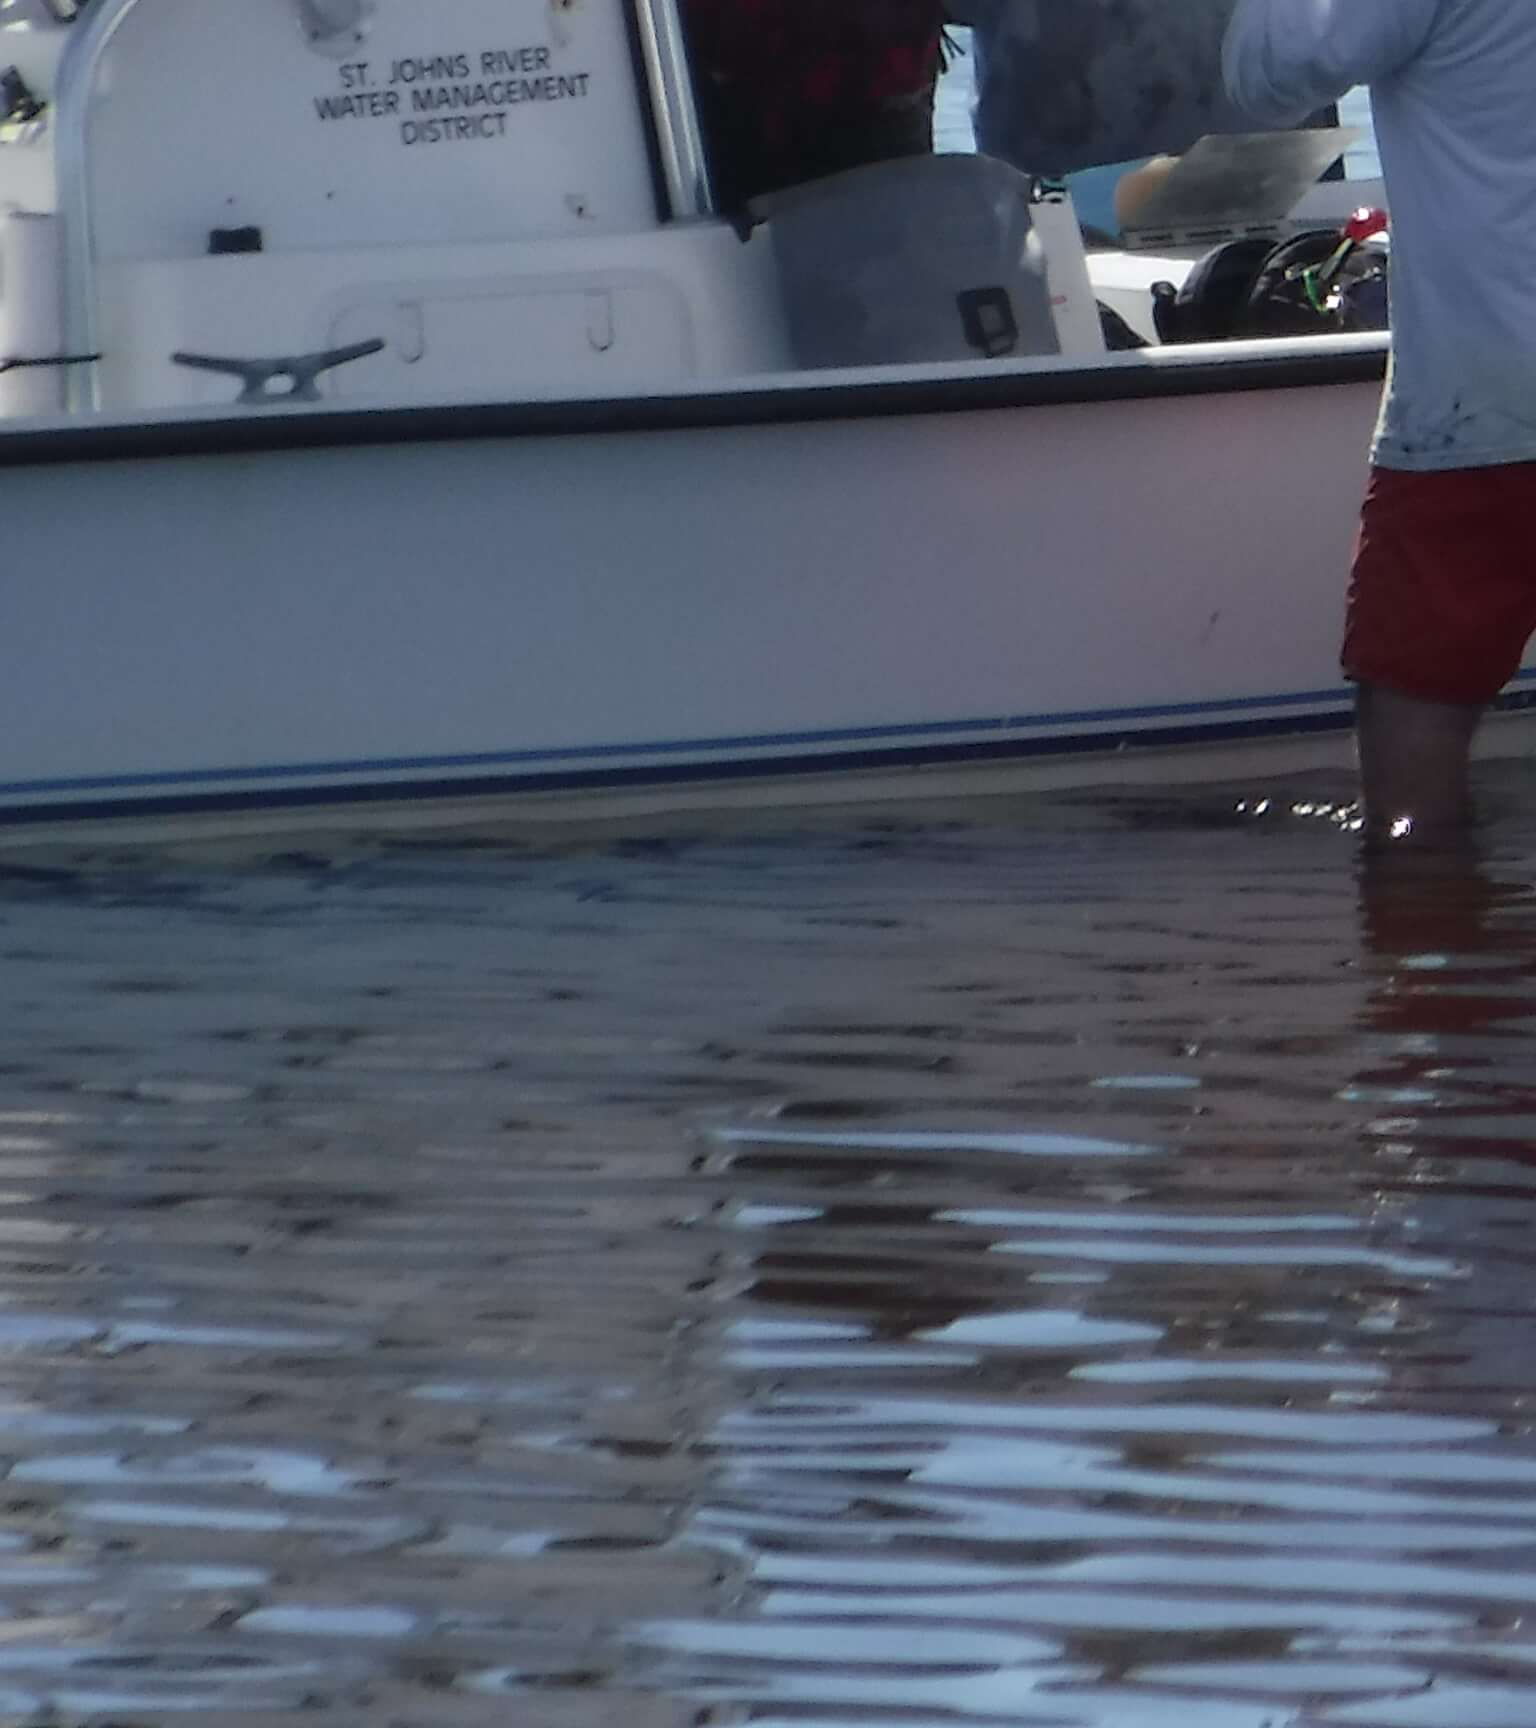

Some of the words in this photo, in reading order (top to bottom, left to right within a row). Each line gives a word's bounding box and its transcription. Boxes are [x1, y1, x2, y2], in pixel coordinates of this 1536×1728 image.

[338, 62, 376, 88] ST.
[389, 54, 470, 85] JOHNS
[480, 47, 551, 73] RIVER
[313, 90, 399, 120] WATER
[411, 73, 590, 112] MANAGEMENT
[401, 113, 507, 145] DISTRICT
